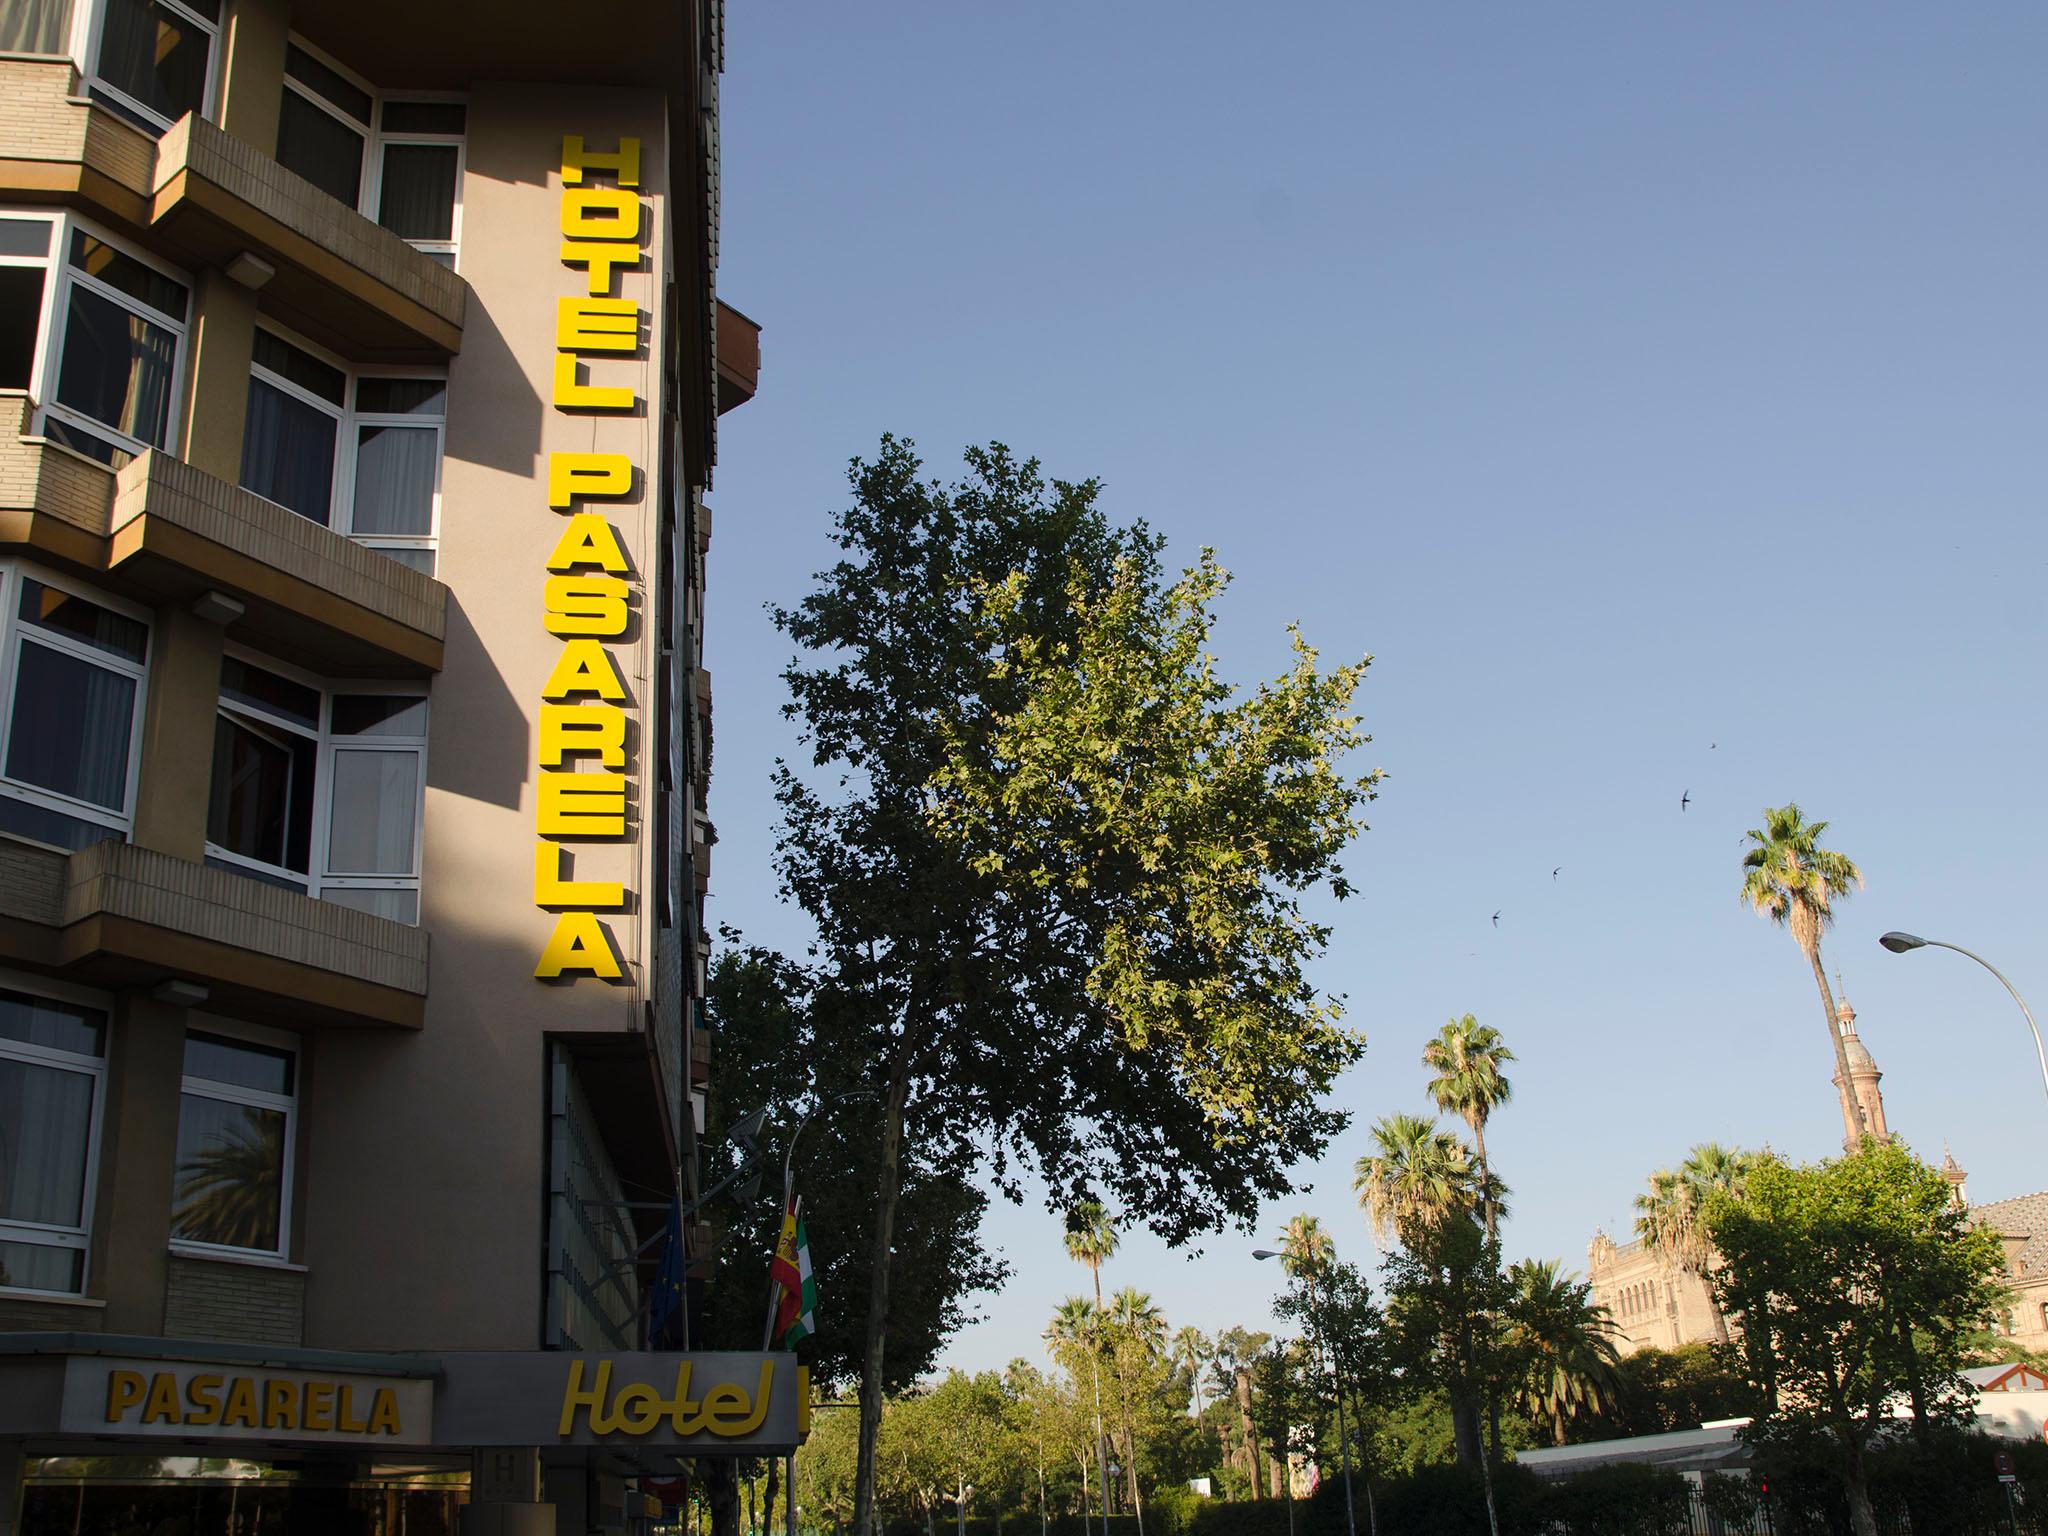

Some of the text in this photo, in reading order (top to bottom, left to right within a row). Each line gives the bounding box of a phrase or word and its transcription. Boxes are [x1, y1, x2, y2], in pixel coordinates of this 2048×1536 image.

[534, 135, 640, 980] HOTEL PASARELA
[106, 1370, 402, 1435] PASARELA
[558, 1359, 775, 1439] Hotel
[495, 1454, 515, 1482] H
